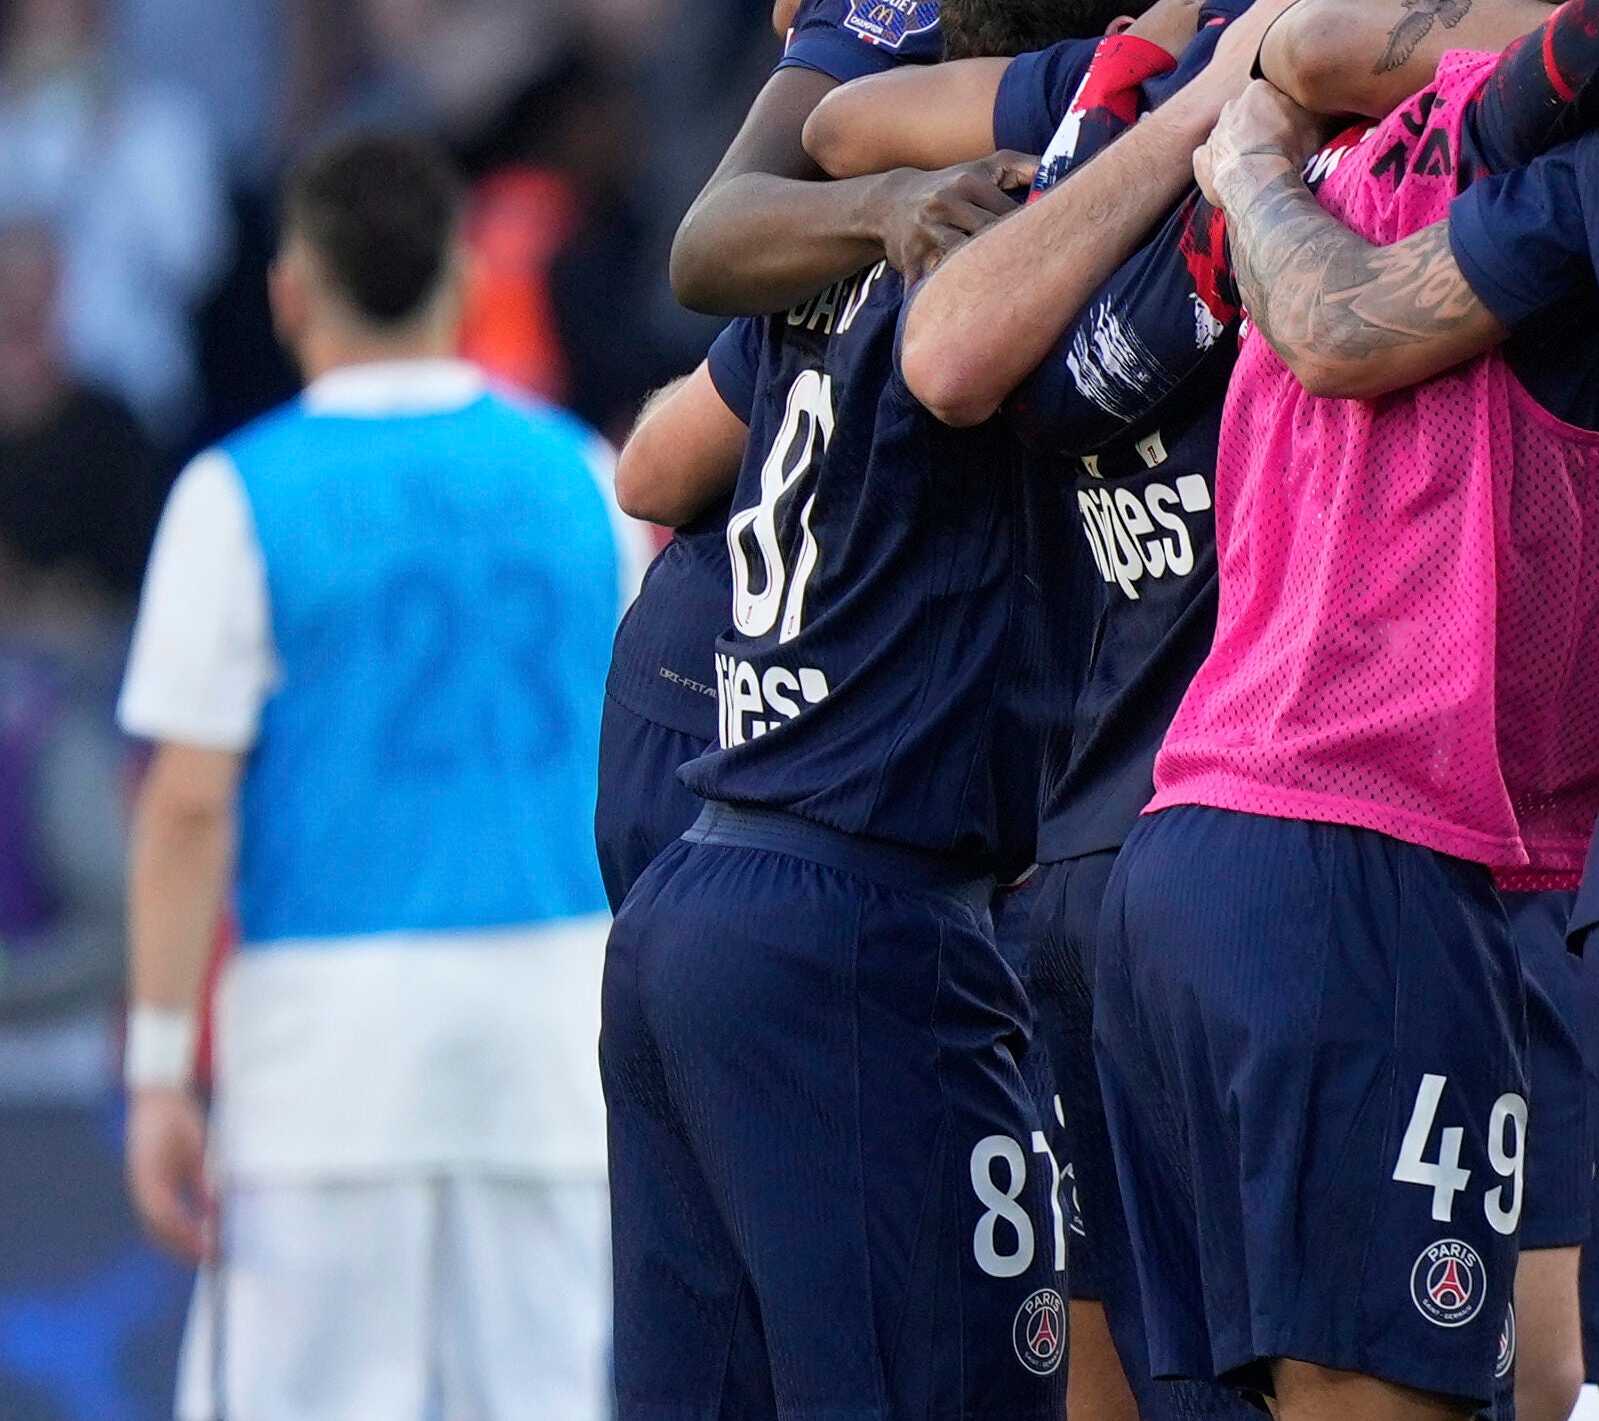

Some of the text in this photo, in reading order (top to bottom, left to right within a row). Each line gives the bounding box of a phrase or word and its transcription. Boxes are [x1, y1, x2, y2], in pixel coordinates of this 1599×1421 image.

[1392, 1073, 1528, 1236] 49
[970, 1130, 1066, 1278] 87
[1427, 1243, 1477, 1268] PARIS
[1025, 1292, 1061, 1315] PARIS
